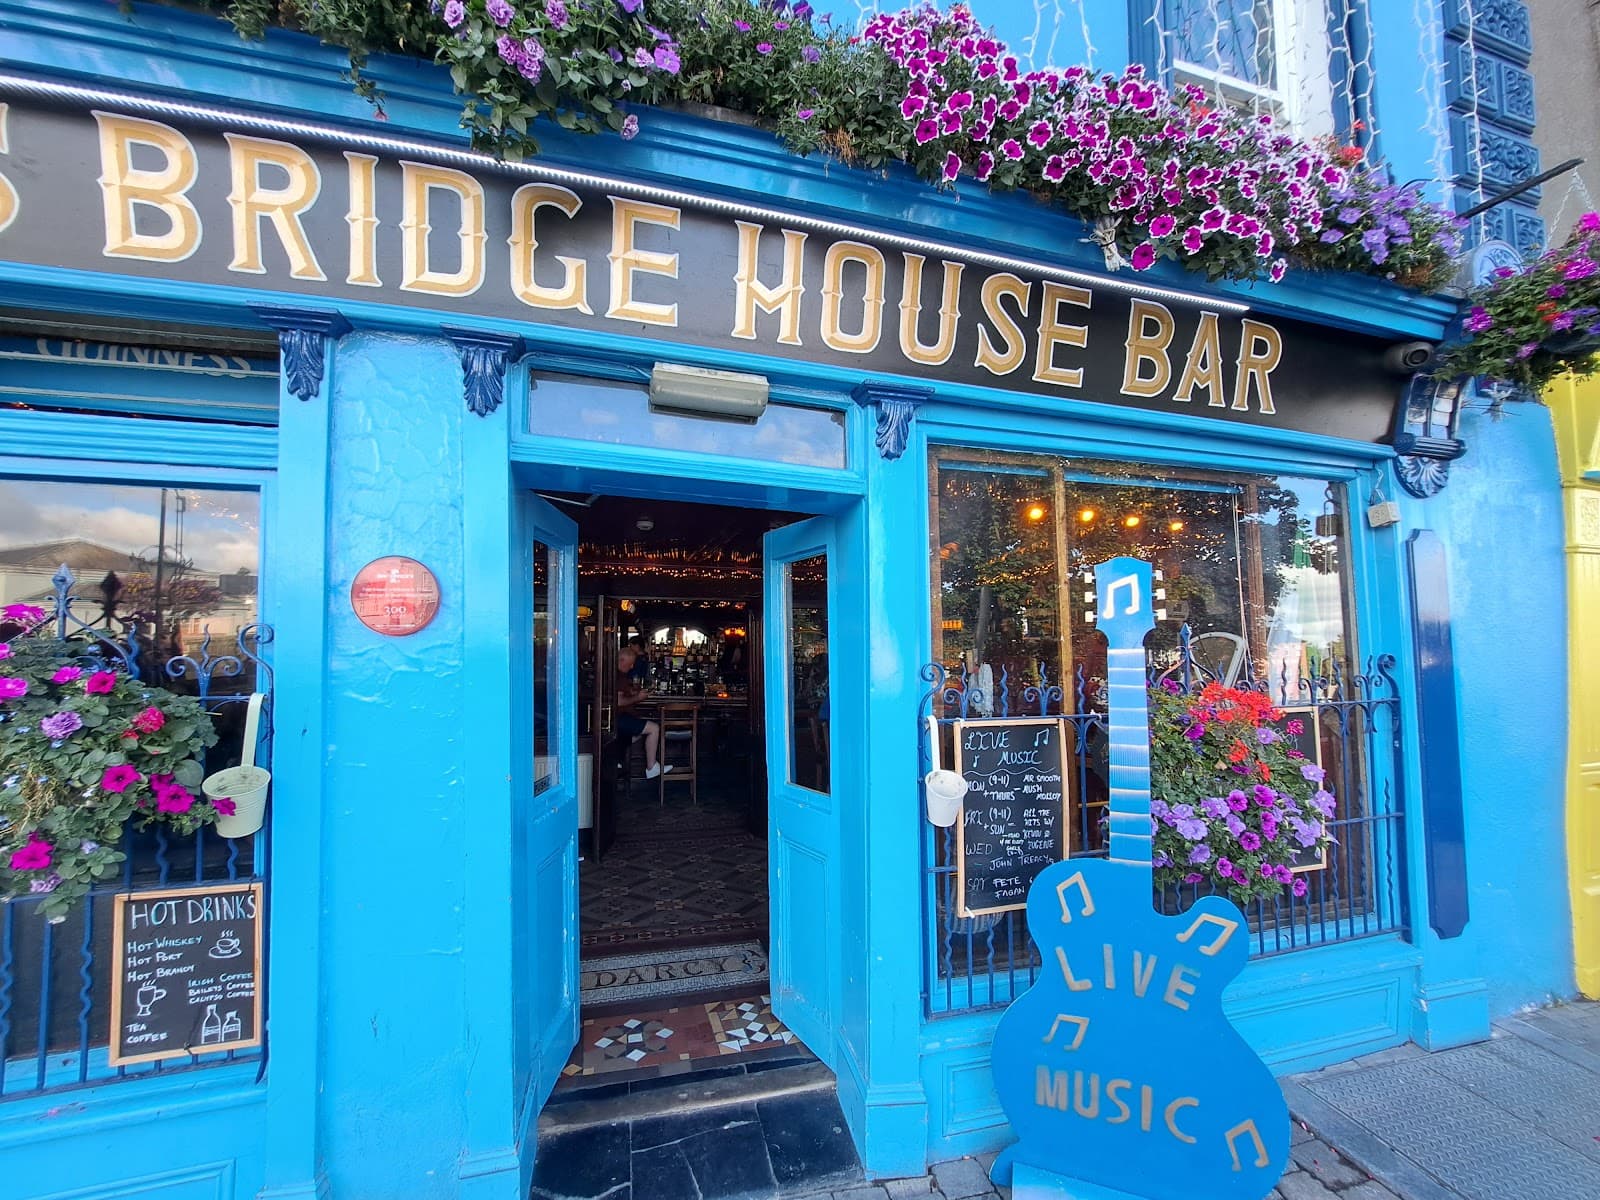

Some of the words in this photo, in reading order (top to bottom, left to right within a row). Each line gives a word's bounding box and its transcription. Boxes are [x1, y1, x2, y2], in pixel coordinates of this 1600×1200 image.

[91, 109, 682, 328] BRIDGE
[731, 219, 1093, 388] HOUSE
[1119, 297, 1283, 415] BAR
[964, 729, 1011, 750] LIVE
[997, 751, 1043, 766] MUSIC
[988, 774, 1010, 789] (9-11)
[990, 790, 1016, 801] THURS
[965, 810, 984, 827] FRI
[989, 806, 1012, 822] (9-11)
[990, 823, 1005, 835] SUN
[966, 842, 993, 856] WED
[989, 856, 1013, 870] JOHN
[967, 877, 986, 891] SAT
[992, 876, 1022, 888] PETE
[995, 886, 1025, 899] FAGAN
[131, 900, 183, 930] HOT
[188, 894, 256, 924] DRINKS
[127, 942, 153, 954] HOT
[155, 935, 203, 949] WHISKEY
[127, 956, 153, 969] HOT
[156, 951, 184, 962] PORT
[127, 971, 153, 983] HOT
[156, 965, 195, 978] BRANDY
[1055, 943, 1201, 1011] LIVE
[188, 977, 214, 988] IRISH
[126, 1023, 147, 1033] TEA
[126, 1032, 169, 1044] COFFEE
[1035, 1064, 1201, 1144] MUSIC
